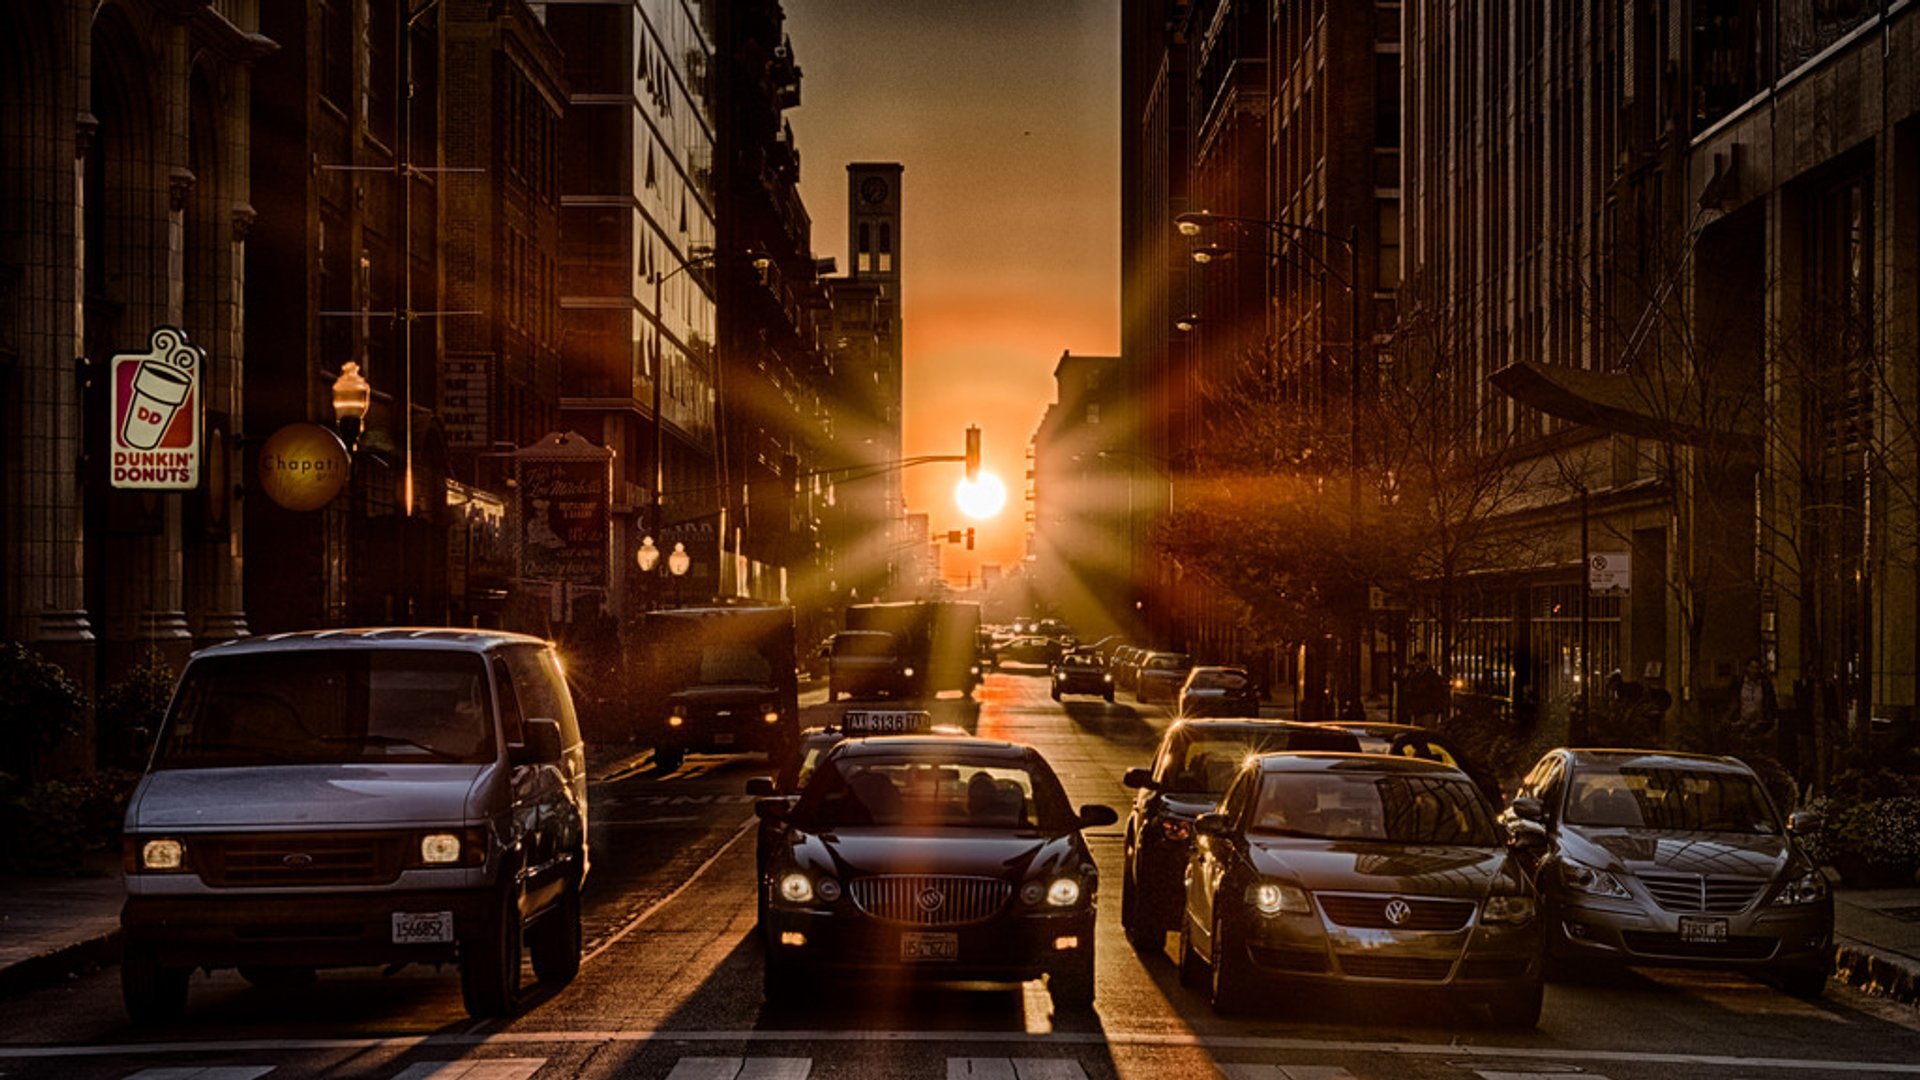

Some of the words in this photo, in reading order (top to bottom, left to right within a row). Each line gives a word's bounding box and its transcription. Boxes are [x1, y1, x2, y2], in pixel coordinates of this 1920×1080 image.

[138, 407, 162, 425] DD
[114, 452, 193, 467] DUNKIN'
[114, 468, 190, 482] DONUTS
[846, 714, 866, 729] TAXI
[871, 714, 904, 731] 3136
